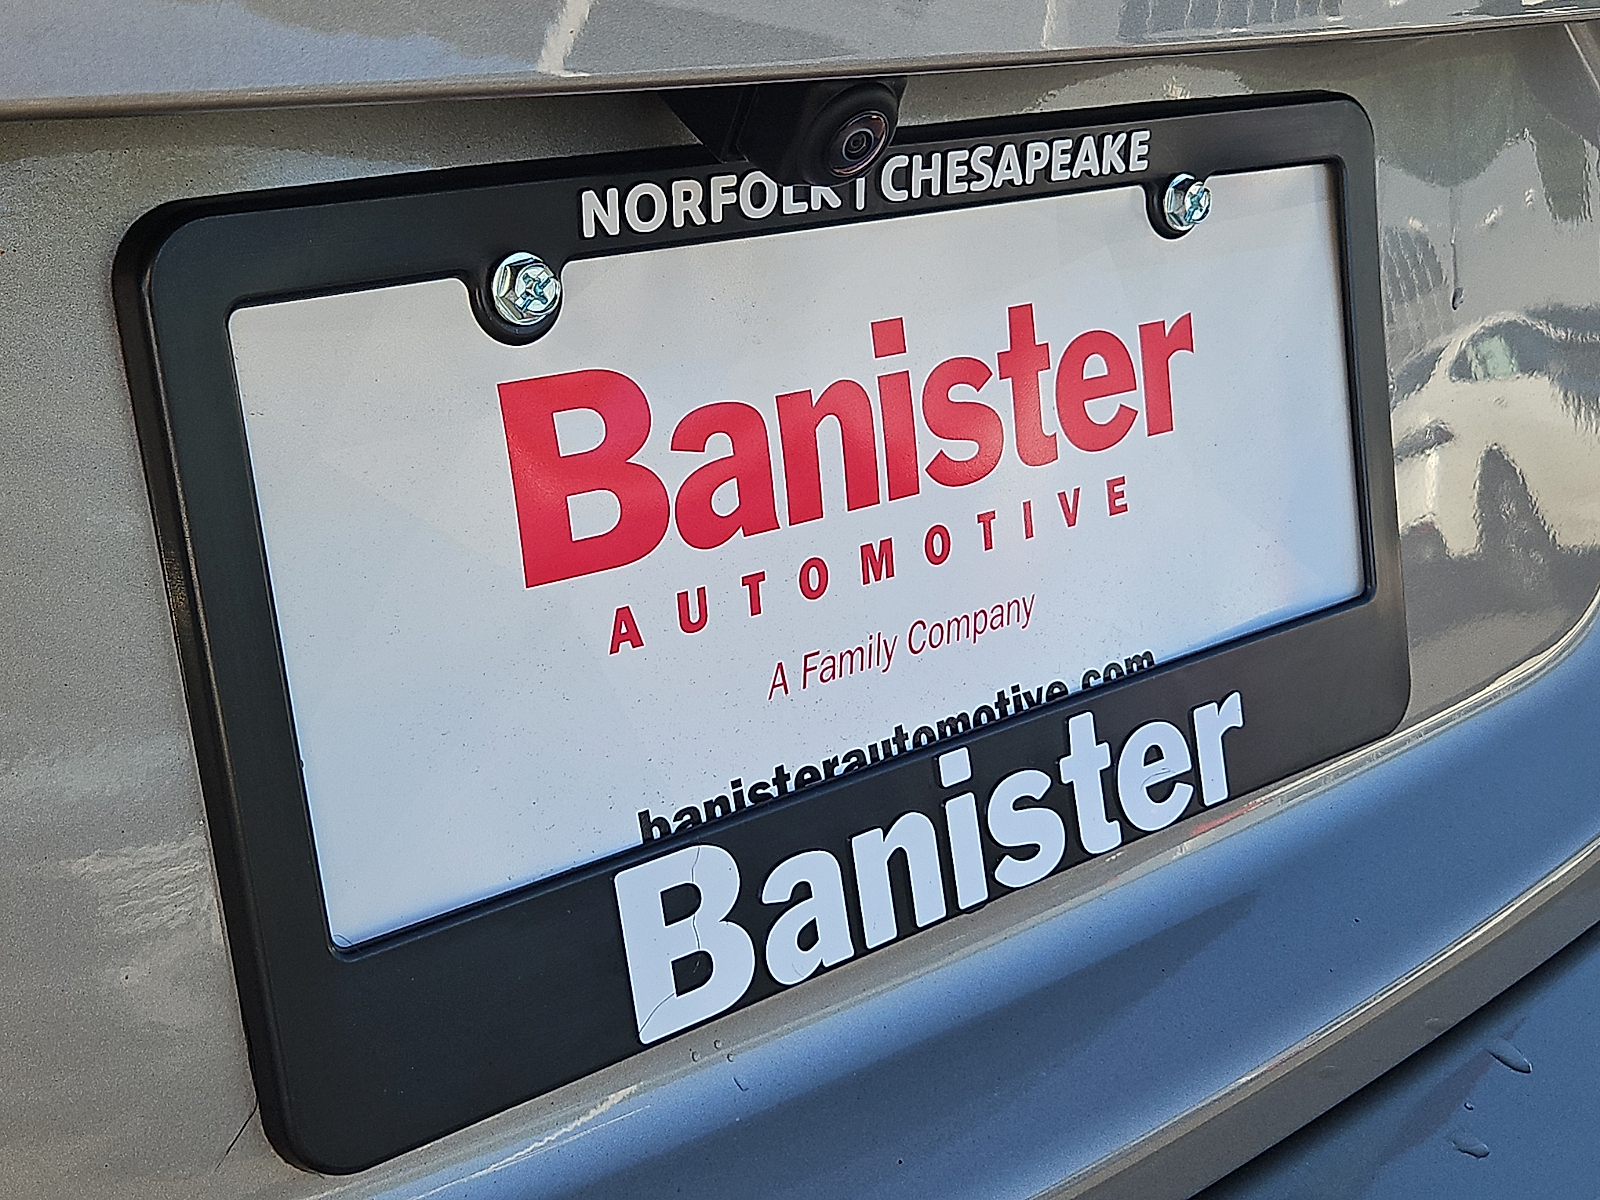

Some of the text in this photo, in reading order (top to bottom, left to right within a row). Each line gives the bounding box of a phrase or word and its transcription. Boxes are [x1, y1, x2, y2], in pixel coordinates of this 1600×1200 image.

[881, 130, 1151, 202] CHESAPEAKE
[497, 303, 1194, 589] Banister
[608, 475, 1130, 655] AUTOMOTIVE
[767, 593, 1035, 700] A Family Company
[638, 650, 1155, 844] banisterautomotivecom
[614, 691, 1245, 1045] Banister
